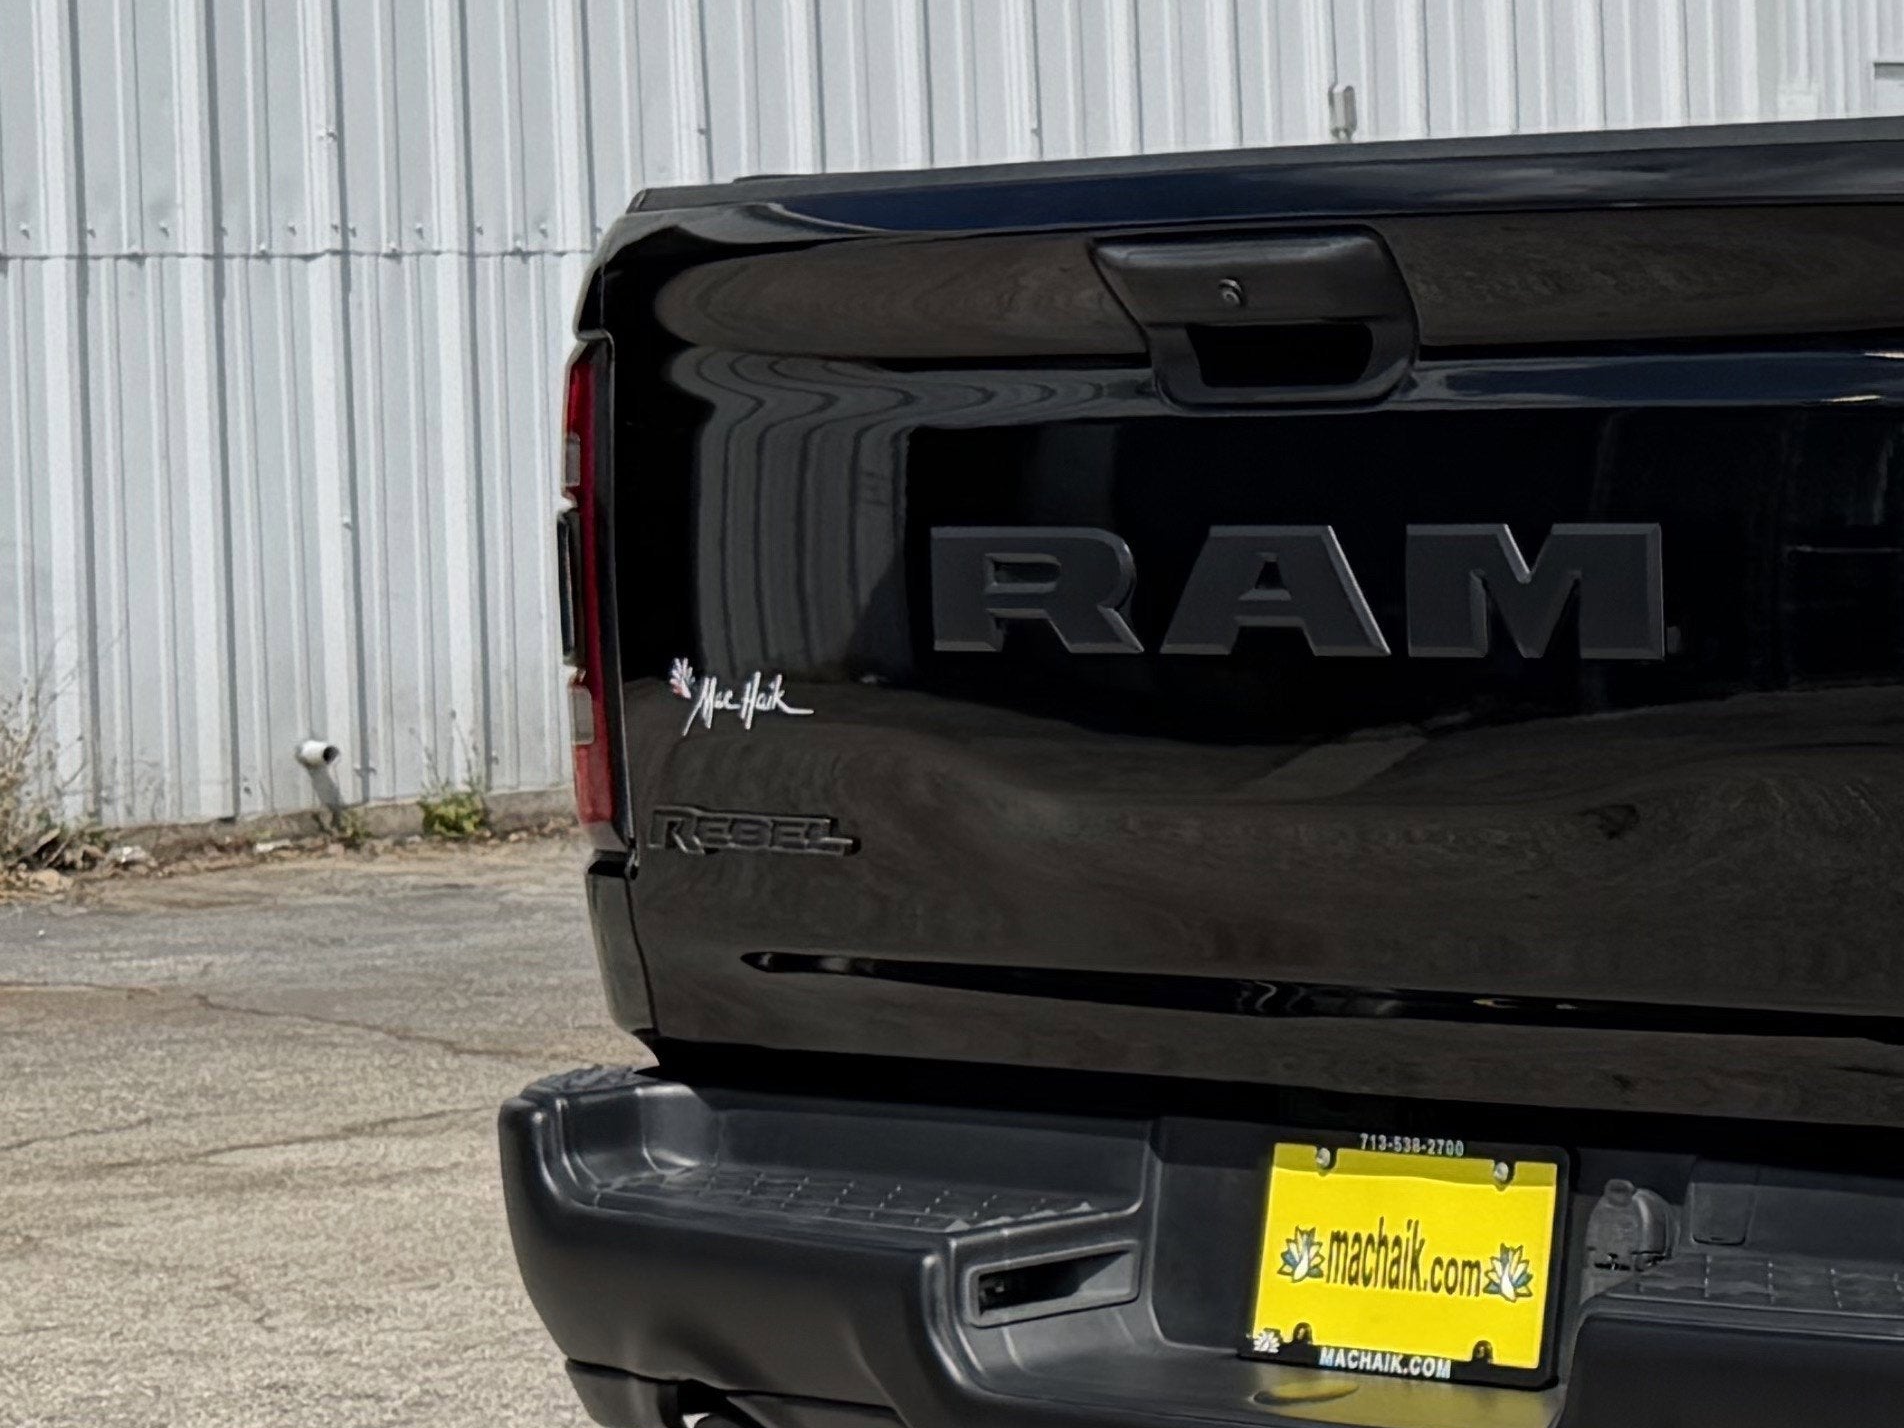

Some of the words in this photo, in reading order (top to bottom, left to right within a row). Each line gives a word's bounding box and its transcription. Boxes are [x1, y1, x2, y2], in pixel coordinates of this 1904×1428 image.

[931, 524, 1664, 660] RAM
[1325, 1216, 1483, 1297] machaik.com
[1318, 1347, 1452, 1379] MACHAIK.COM
